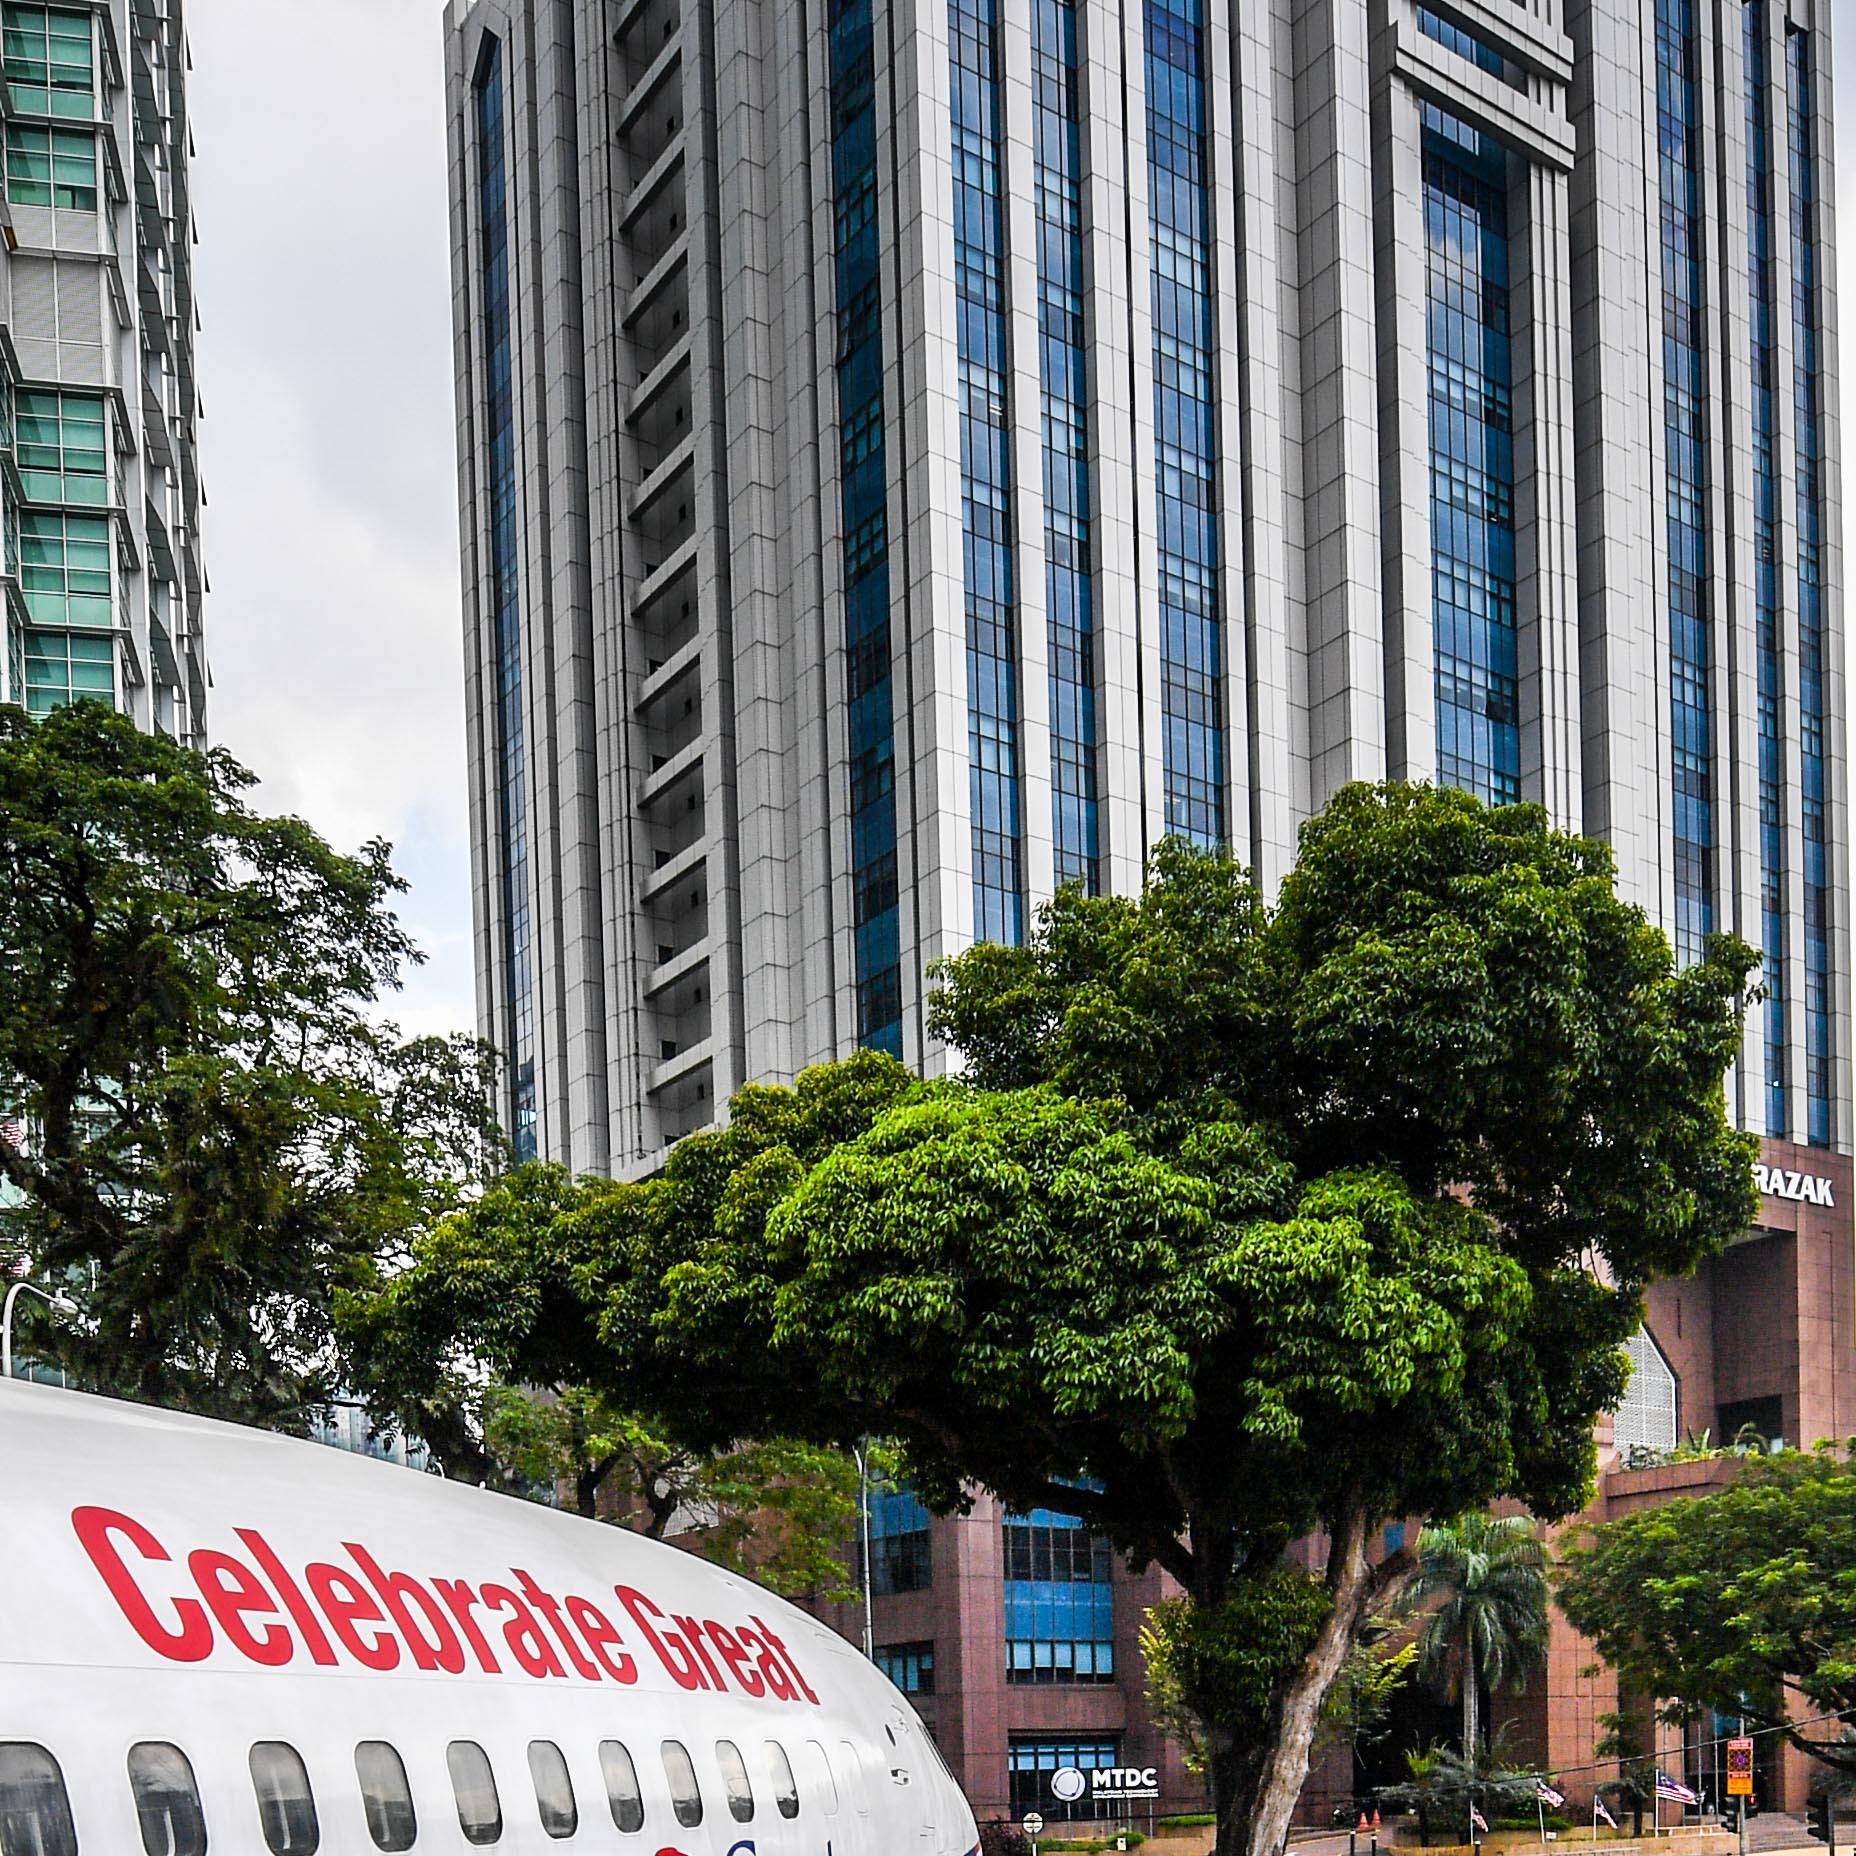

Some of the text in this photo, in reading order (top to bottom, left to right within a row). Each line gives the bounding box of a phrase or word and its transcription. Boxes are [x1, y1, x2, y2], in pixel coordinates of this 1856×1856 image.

[1751, 1163, 1834, 1207] RAZAK
[72, 1506, 820, 1705] Celebrate Great
[1092, 1768, 1157, 1788] MTDC
